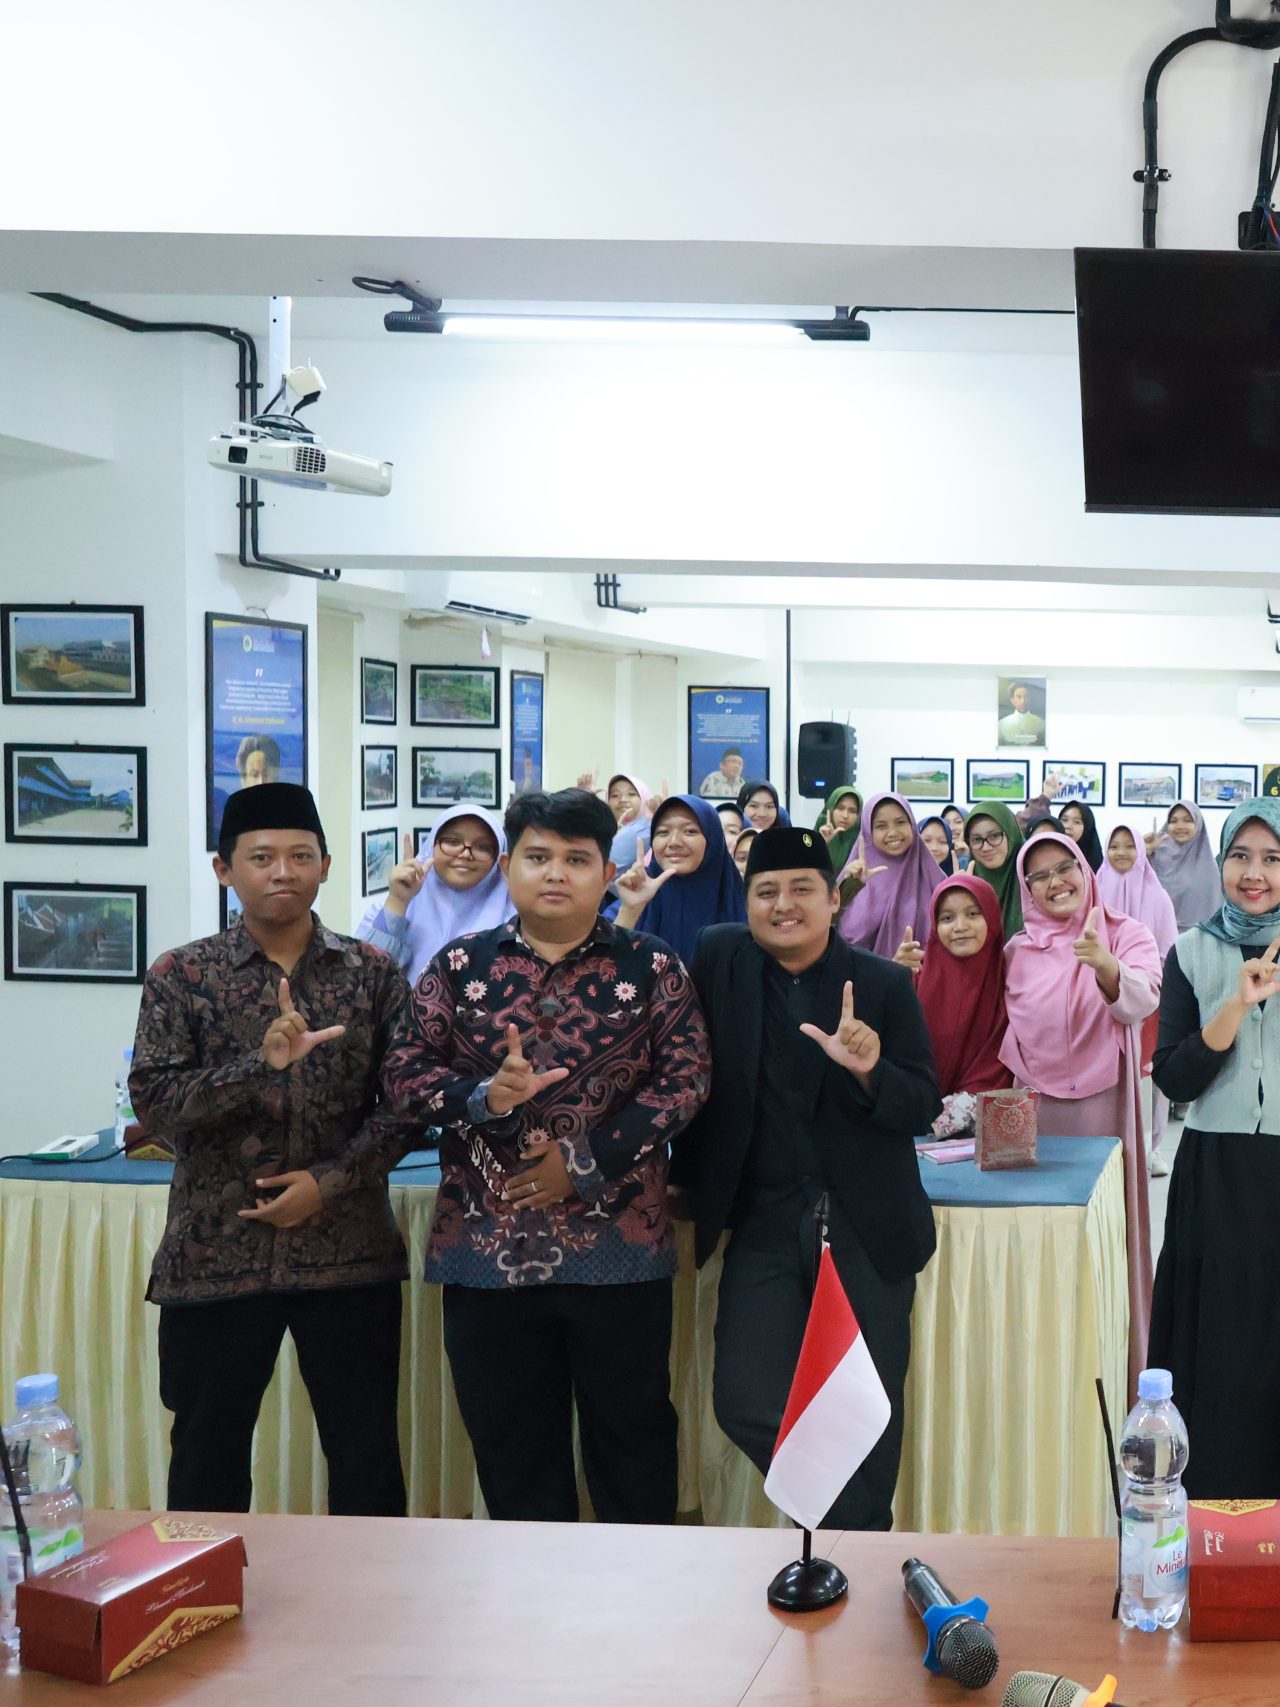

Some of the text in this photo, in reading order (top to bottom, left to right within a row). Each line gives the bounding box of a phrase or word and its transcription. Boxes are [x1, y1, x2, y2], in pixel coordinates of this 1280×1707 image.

[1271, 786, 1279, 796] 6
[1172, 1550, 1183, 1561] Le
[1156, 1559, 1186, 1575] Miner
